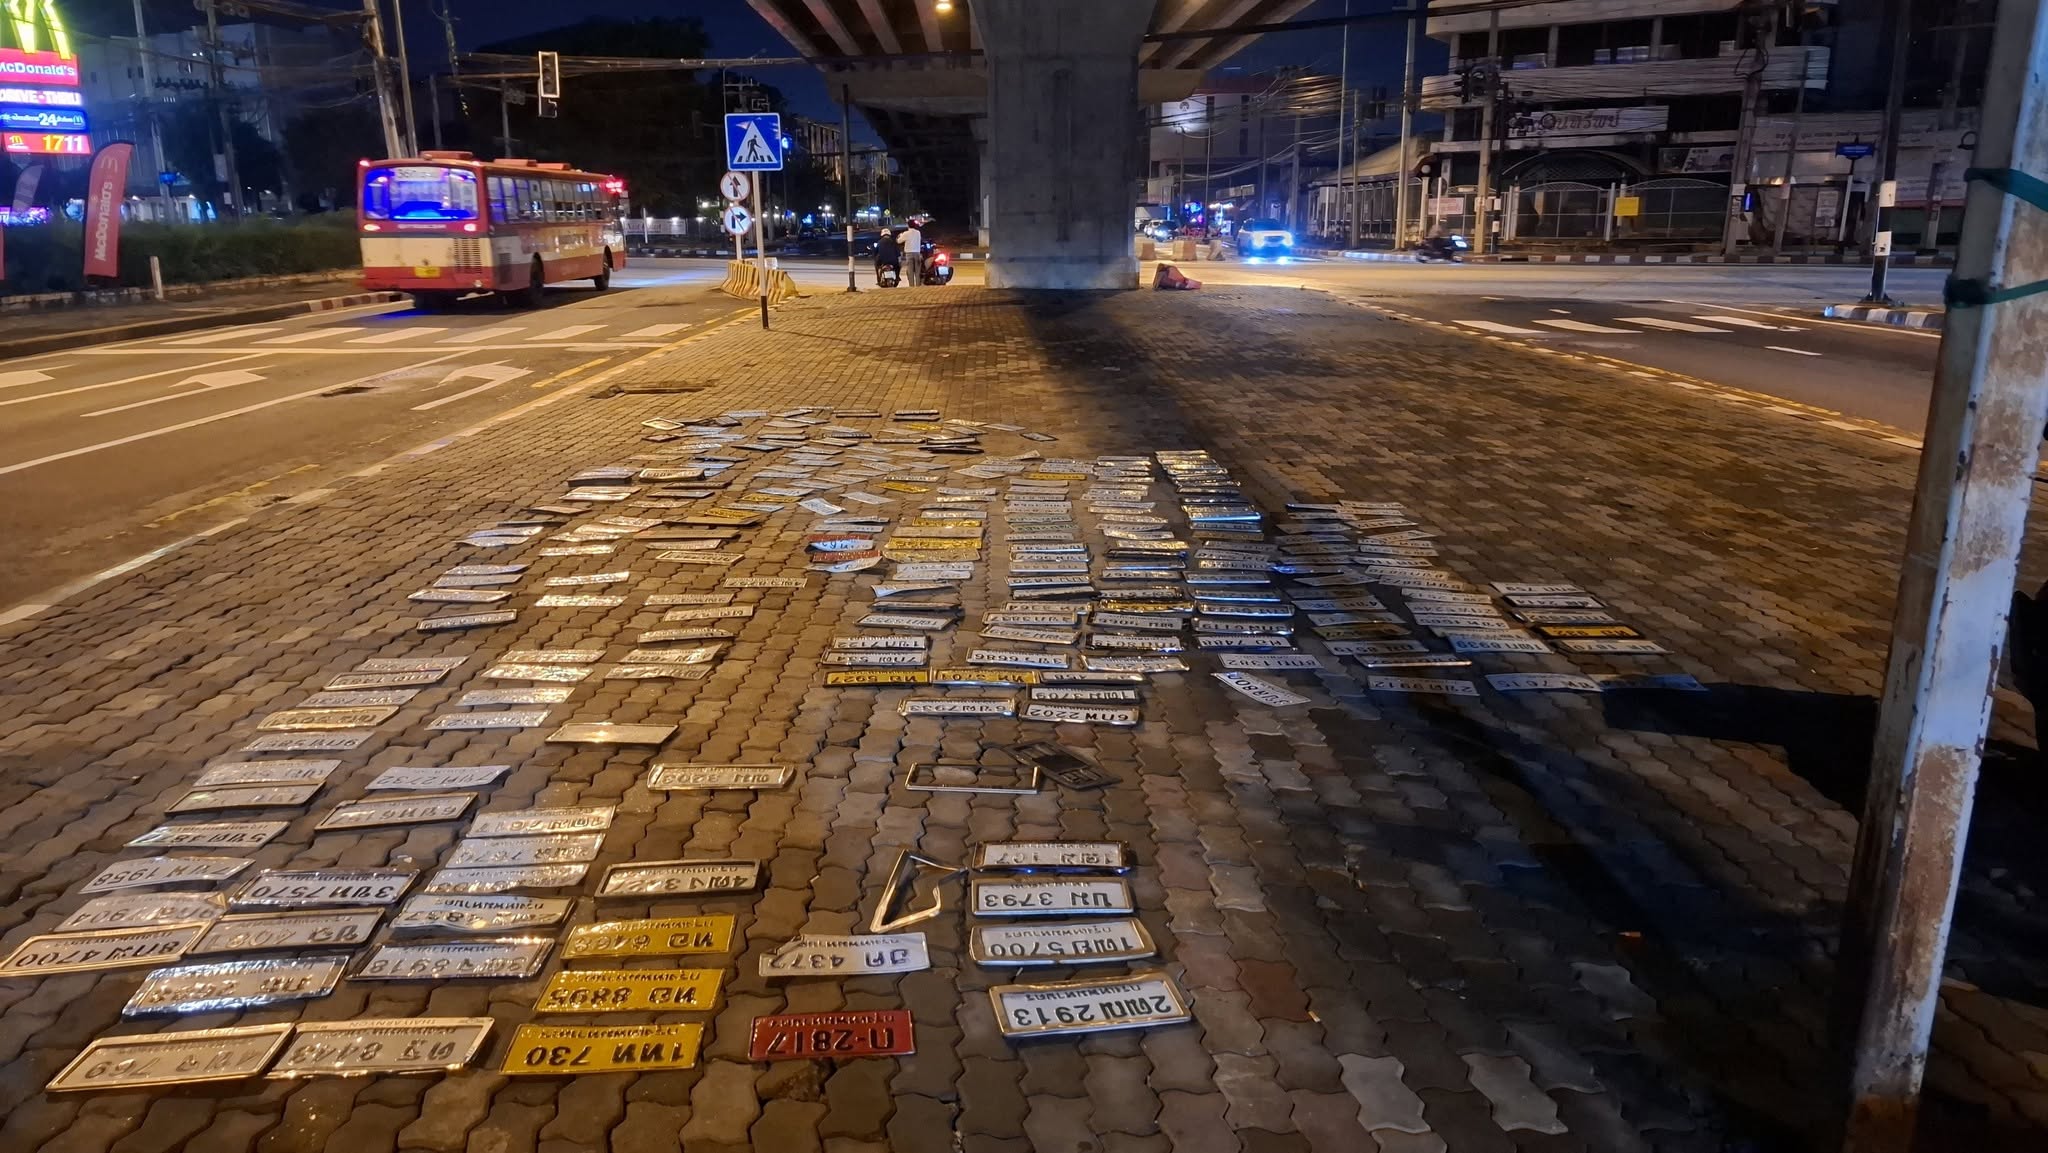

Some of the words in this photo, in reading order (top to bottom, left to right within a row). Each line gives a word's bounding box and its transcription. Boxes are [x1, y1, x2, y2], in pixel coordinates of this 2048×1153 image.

[38, 113, 58, 126] 24
[43, 134, 83, 152] 1711
[95, 181, 113, 262] McDonald's
[251, 886, 325, 899] 7570
[983, 892, 1053, 907] 3793
[1070, 892, 1112, 907] บม
[1004, 925, 1112, 939] กรุงเทพมหานคร
[988, 941, 1063, 957] 5700
[15, 950, 101, 968] 4700
[368, 958, 451, 974] 8918
[1012, 1003, 1095, 1026] 2913
[288, 1042, 383, 1066] 8443
[524, 1045, 592, 1067] 730
[85, 1057, 161, 1079] 769
